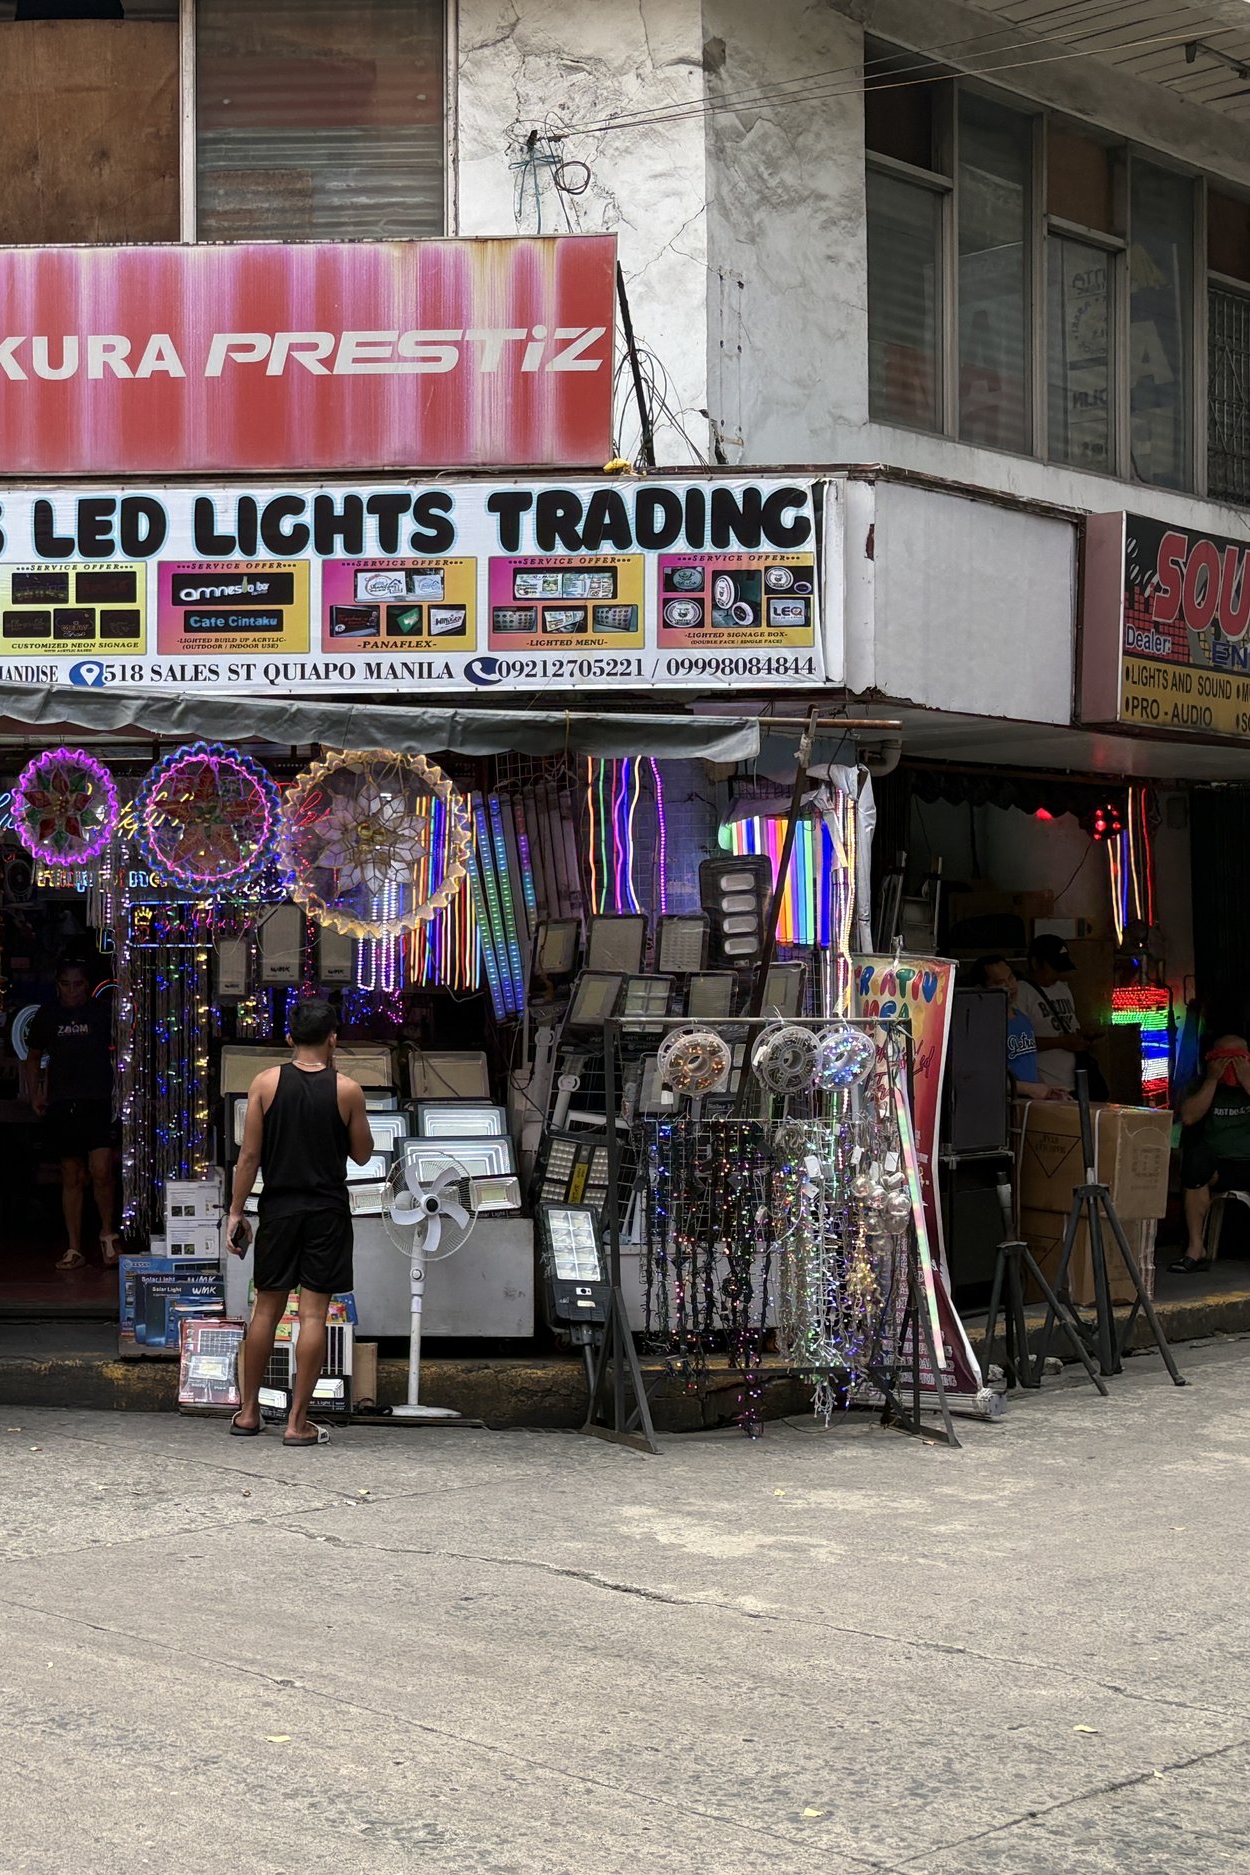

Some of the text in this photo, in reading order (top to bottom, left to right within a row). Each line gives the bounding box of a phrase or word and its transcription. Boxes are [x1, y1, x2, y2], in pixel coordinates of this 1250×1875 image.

[34, 496, 167, 559] LED
[194, 491, 454, 557] LIGHTS
[488, 485, 812, 553] TRADING
[189, 615, 278, 628] Cafe Cintaku
[1126, 623, 1171, 654] Dealer:
[104, 664, 144, 682] 518
[151, 664, 220, 682] SALES
[227, 663, 257, 681] ST
[263, 661, 356, 687] QUIAPO
[363, 661, 455, 680] MANILA
[498, 656, 816, 679] 09212705221 / 09998084844
[1131, 663, 1232, 700] LIGHTS AND SOUND
[1131, 696, 1160, 721] PRO
[1171, 702, 1213, 727] AUDIO
